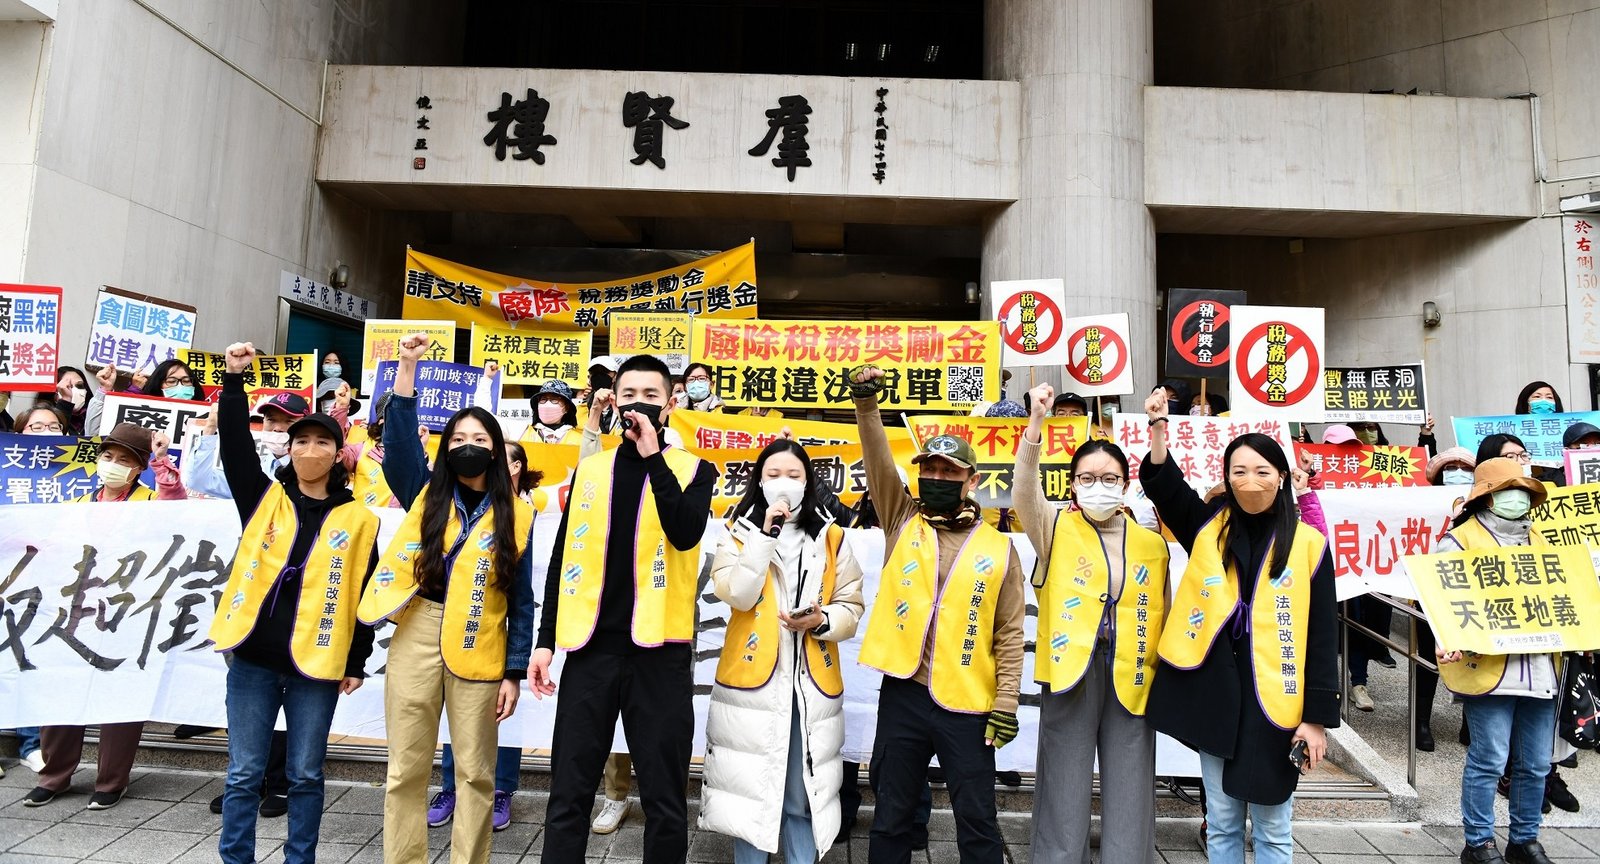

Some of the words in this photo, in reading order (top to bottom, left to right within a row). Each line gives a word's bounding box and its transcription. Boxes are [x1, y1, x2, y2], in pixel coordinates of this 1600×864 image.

[405, 268, 482, 308] 請支持
[497, 288, 571, 323] 廢除
[97, 297, 192, 343] 貪圖獎金
[615, 326, 686, 350] 廢獎金
[1020, 294, 1038, 352] 稅務獎金
[1198, 303, 1215, 363] 執行獎金
[187, 351, 304, 372] 用稅民財
[369, 339, 448, 362] 廢金
[483, 334, 581, 357] 法稅真改革
[702, 323, 987, 364] 廢除稅務獎勵金
[1085, 328, 1103, 383] 稅務獎金
[1266, 324, 1288, 402] 稅務獎金
[484, 358, 580, 380] 心救台灣
[1325, 389, 1418, 409] 民賠光光
[1371, 452, 1408, 475] 廢除
[0, 476, 104, 503] 署執行
[978, 469, 1073, 500] 不明
[1527, 491, 1600, 522] 收不是
[1435, 553, 1567, 590] 超徵還民
[316, 556, 343, 647] 法稅改革聯盟
[463, 557, 490, 649] 法稅改革聯盟
[1450, 594, 1580, 630] 天經地義
[961, 580, 986, 666] 法稅改革聯盟
[1134, 593, 1148, 685] 法稅改革聯盟
[1275, 595, 1298, 695] 法稅改革聯盟
